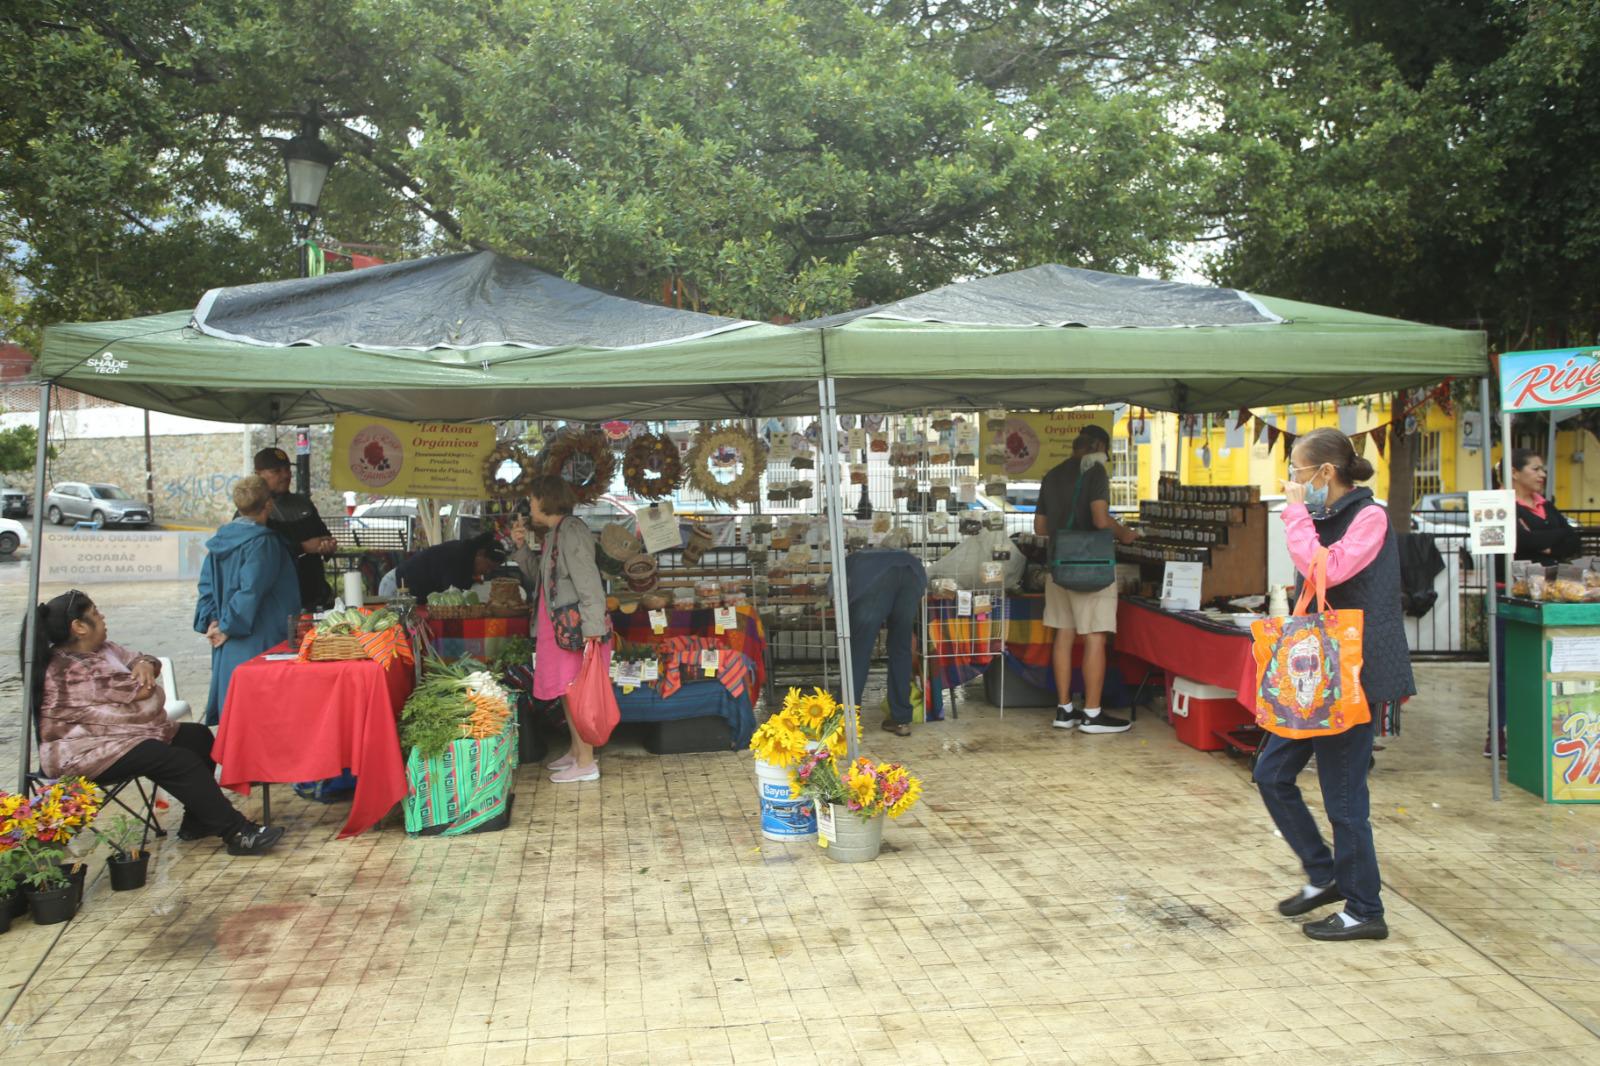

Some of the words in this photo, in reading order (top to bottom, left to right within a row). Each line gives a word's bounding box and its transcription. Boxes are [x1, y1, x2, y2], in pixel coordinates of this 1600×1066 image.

[86, 358, 129, 369] SHADE
[95, 366, 120, 374] TECH
[421, 423, 437, 433] La
[441, 423, 473, 434] Rosa
[412, 436, 480, 449] Orgánicos
[764, 784, 790, 798] Sayer
